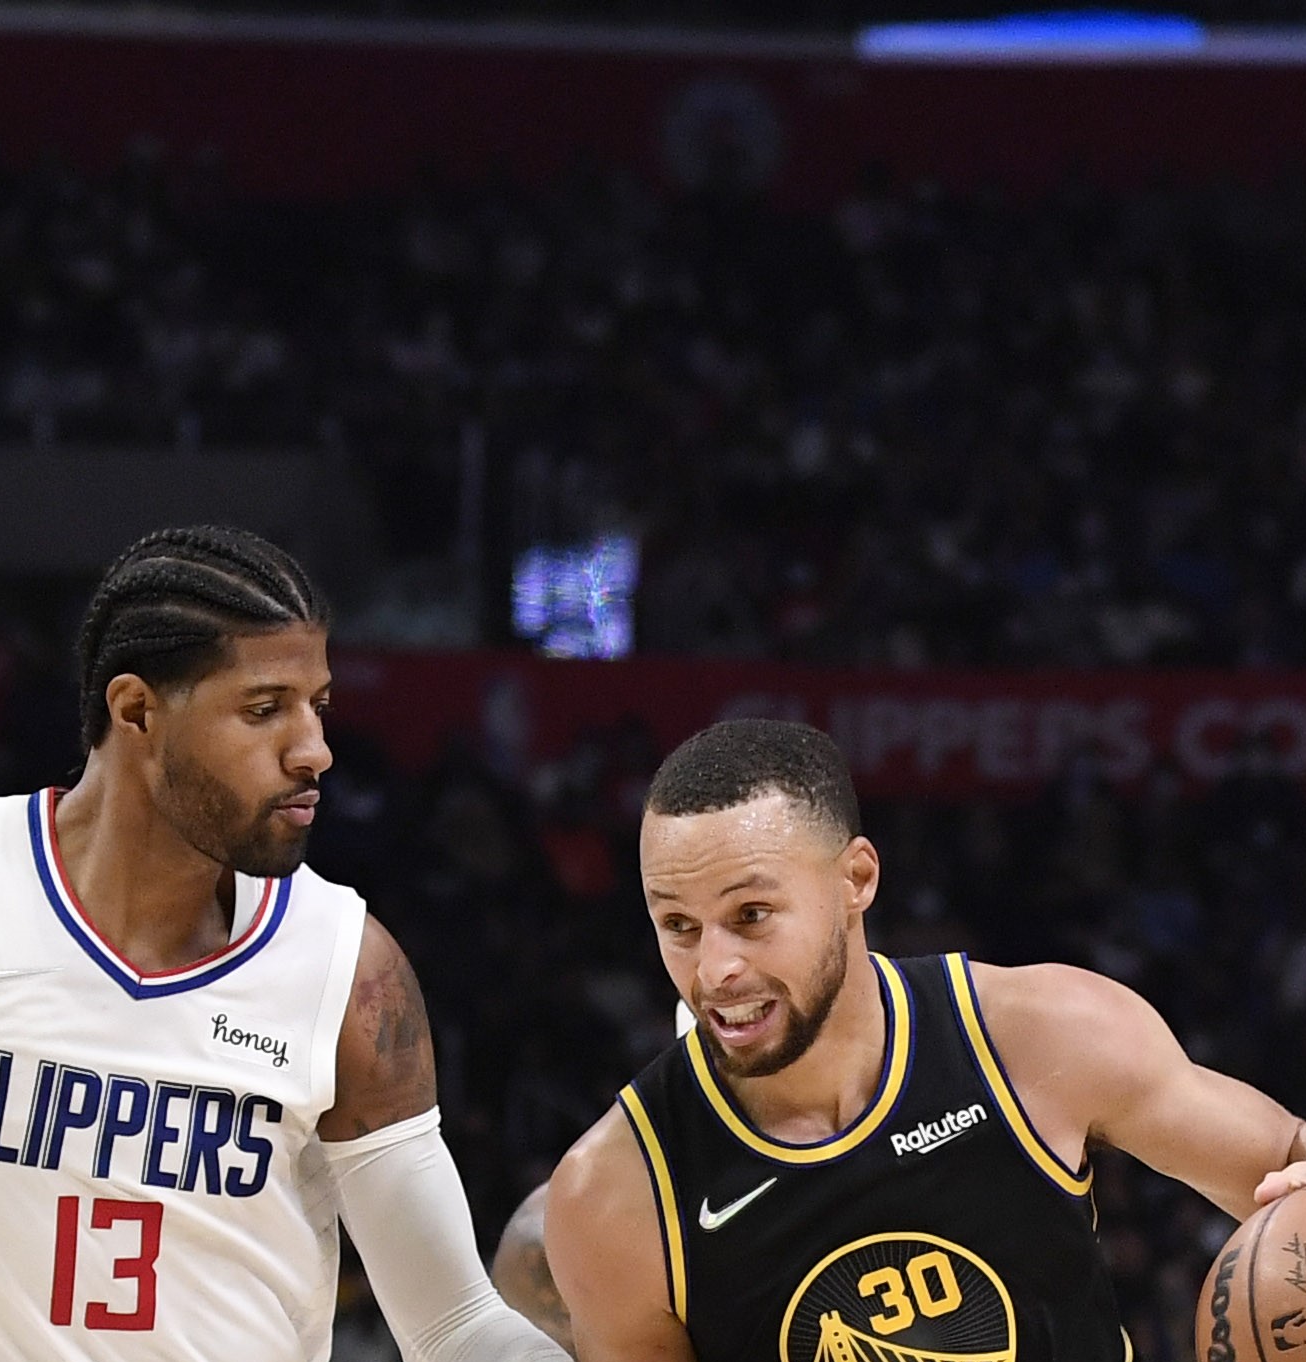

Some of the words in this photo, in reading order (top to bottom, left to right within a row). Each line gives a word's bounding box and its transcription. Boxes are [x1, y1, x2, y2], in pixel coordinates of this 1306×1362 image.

[210, 1013, 290, 1068] honey
[889, 1102, 989, 1157] Rakuten
[49, 1195, 165, 1332] 13
[856, 1249, 964, 1337] 30
